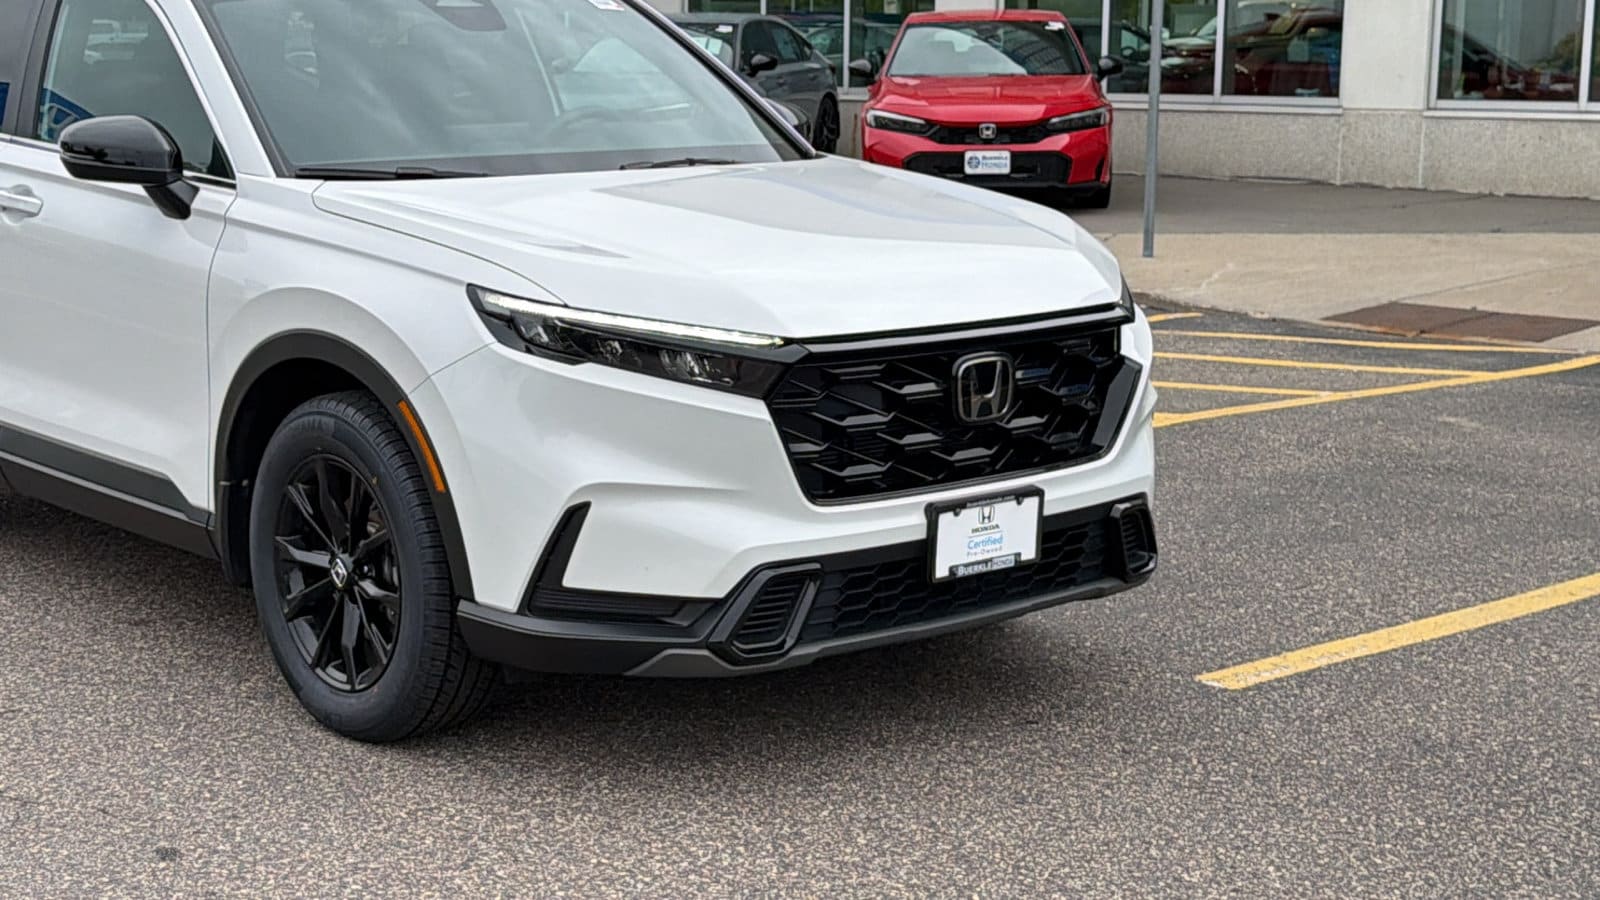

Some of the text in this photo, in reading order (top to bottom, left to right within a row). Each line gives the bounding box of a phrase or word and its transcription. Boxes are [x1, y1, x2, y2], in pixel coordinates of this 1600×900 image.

[971, 524, 1000, 534] HONDA
[967, 535, 1003, 549] Certified
[967, 546, 1003, 557] Pre-Owned
